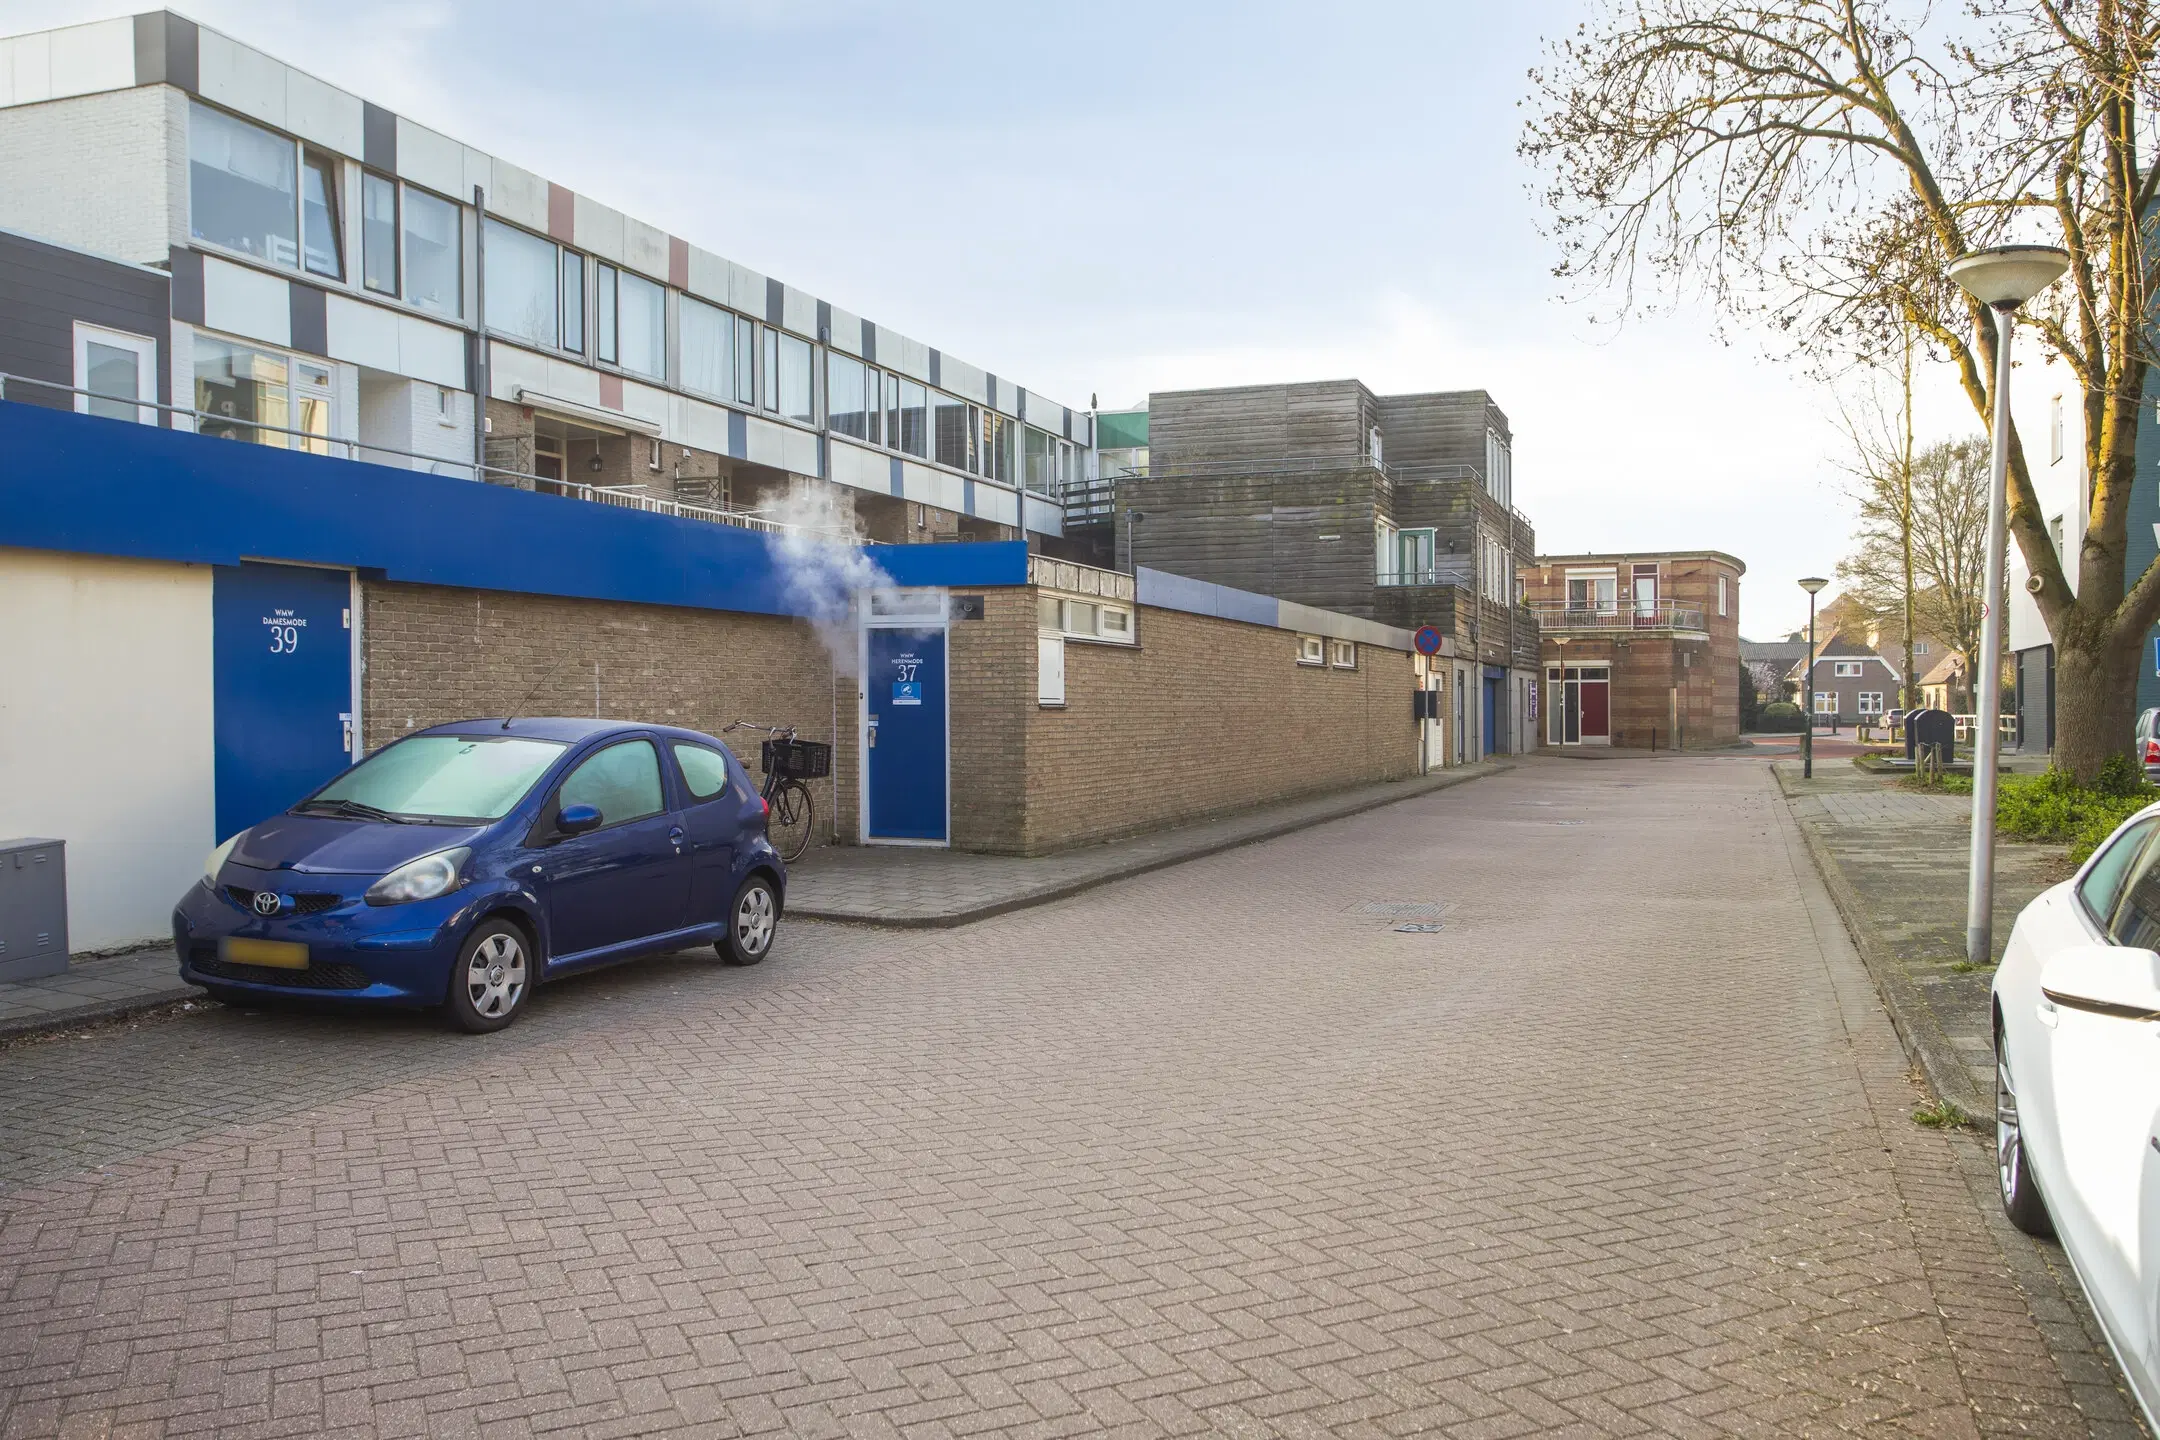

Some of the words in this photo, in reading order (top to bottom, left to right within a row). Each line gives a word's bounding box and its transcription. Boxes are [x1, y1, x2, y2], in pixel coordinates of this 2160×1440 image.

[262, 616, 307, 626] DAMESMODE
[270, 626, 298, 653] 39
[897, 664, 917, 682] 37
